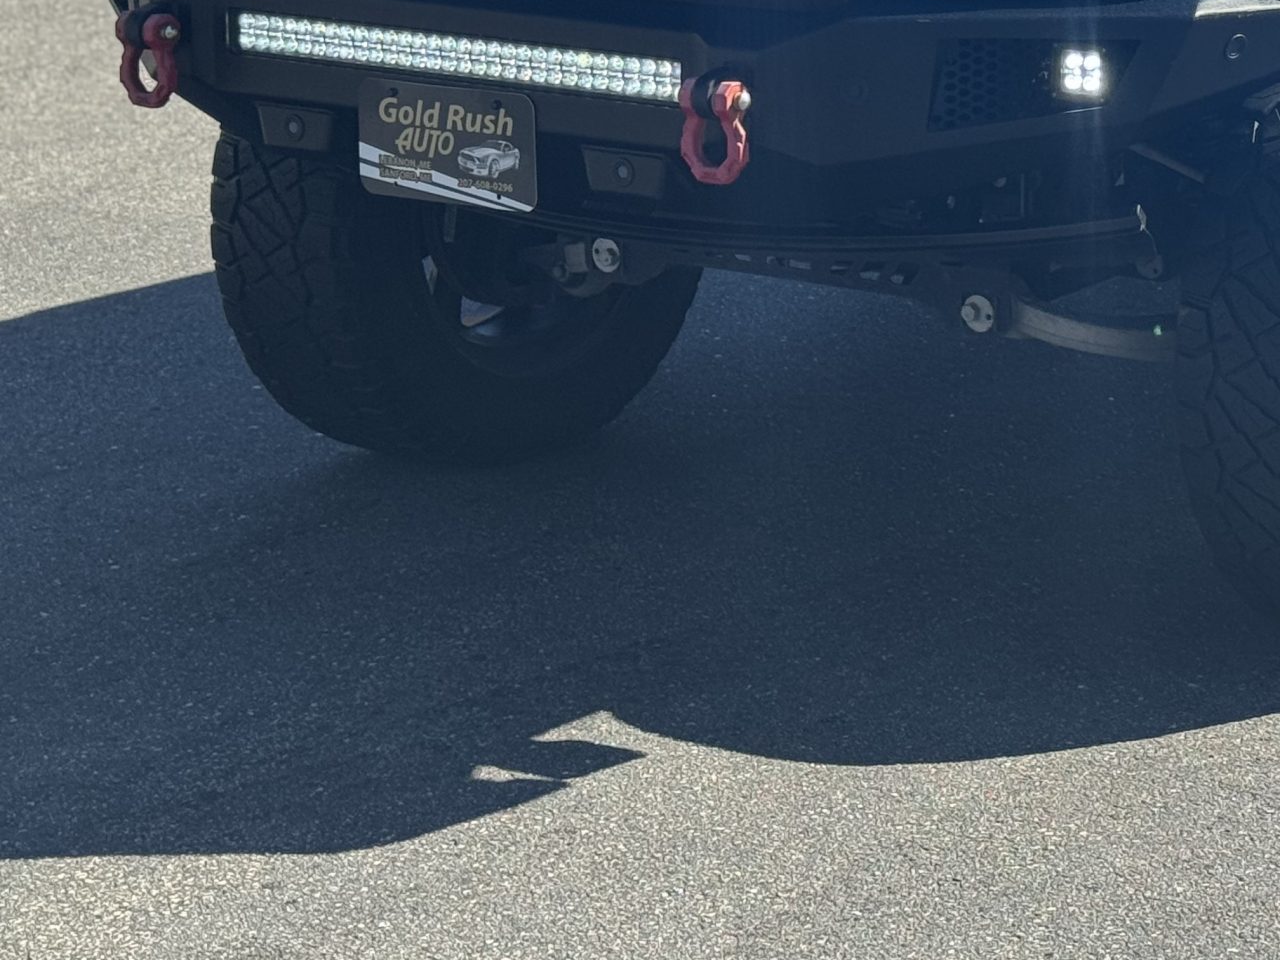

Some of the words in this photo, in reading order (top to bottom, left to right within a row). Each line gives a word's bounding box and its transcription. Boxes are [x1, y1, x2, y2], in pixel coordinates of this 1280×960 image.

[378, 96, 441, 129] Gold
[446, 104, 514, 137] Rush
[394, 127, 455, 158] AUTO
